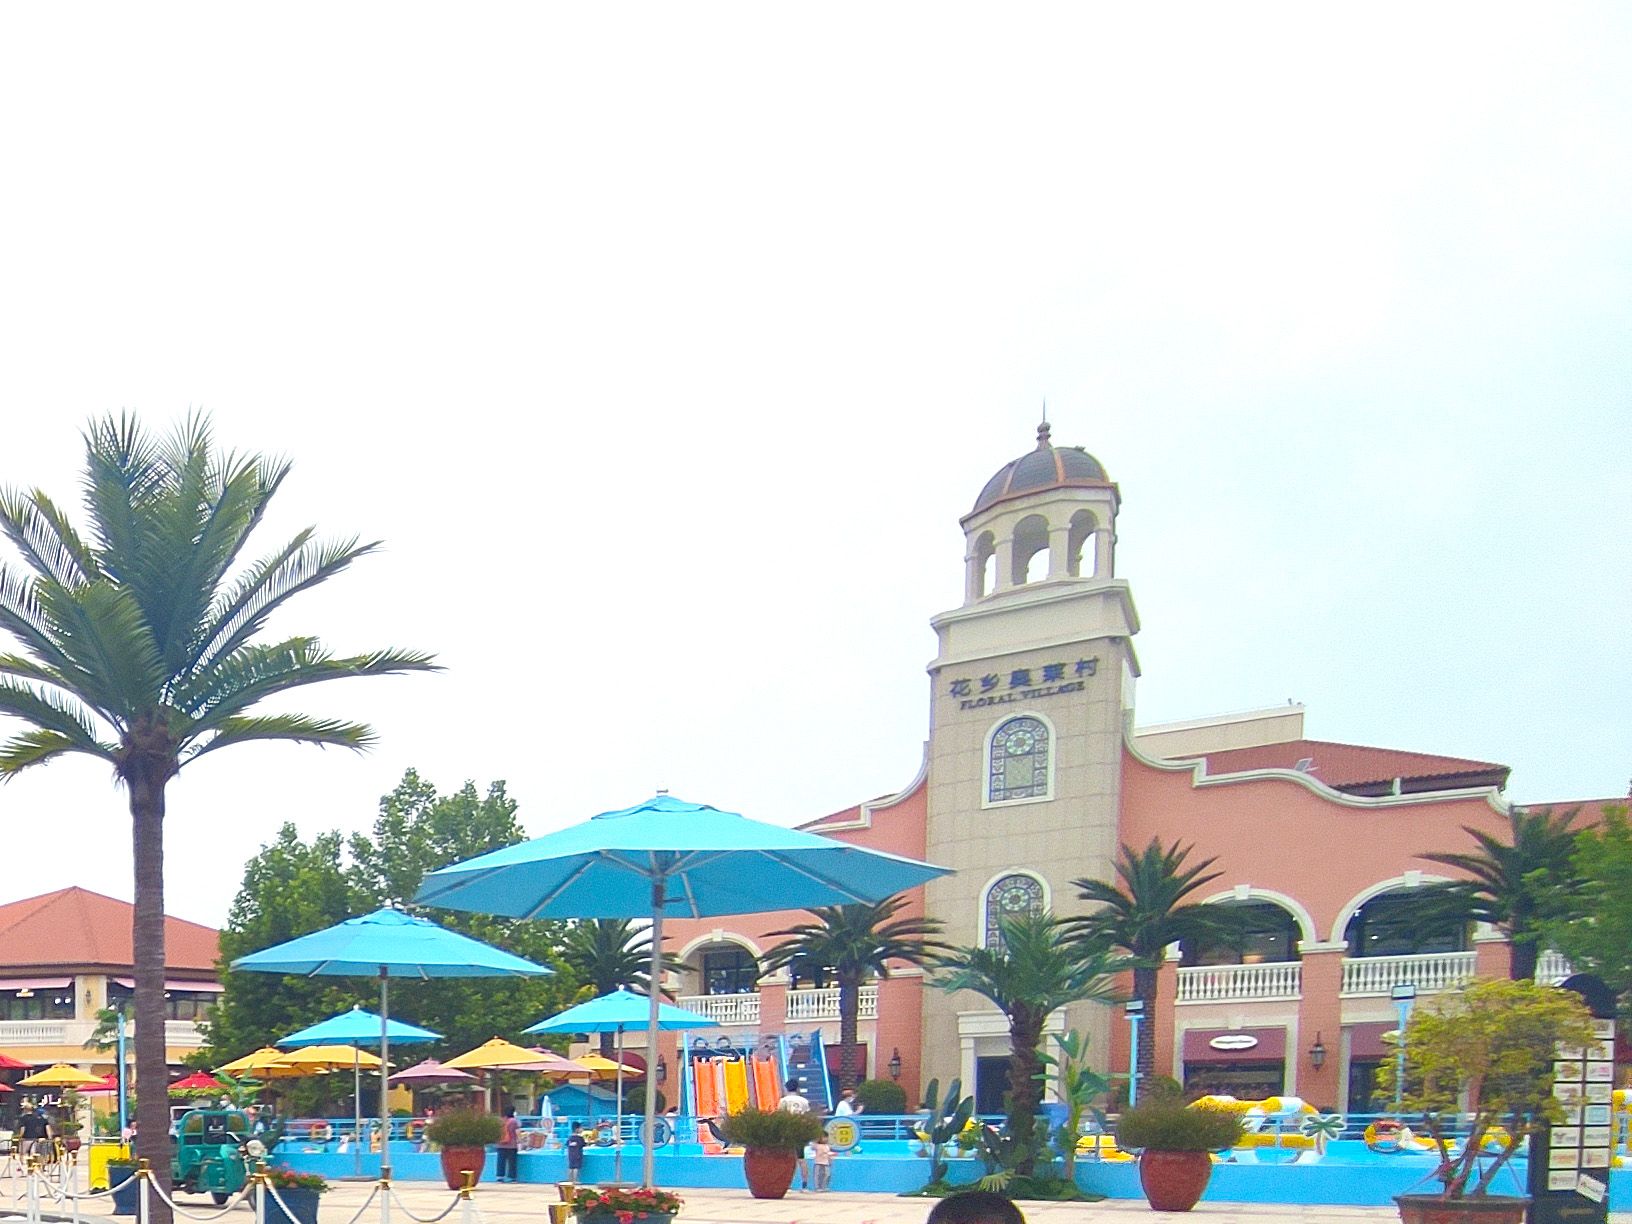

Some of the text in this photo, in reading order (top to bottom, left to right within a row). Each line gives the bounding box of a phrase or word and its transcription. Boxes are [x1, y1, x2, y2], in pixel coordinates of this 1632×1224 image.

[950, 656, 1100, 698] 花乡奥莱村
[960, 681, 1085, 710] FLORAL VILLAGE
